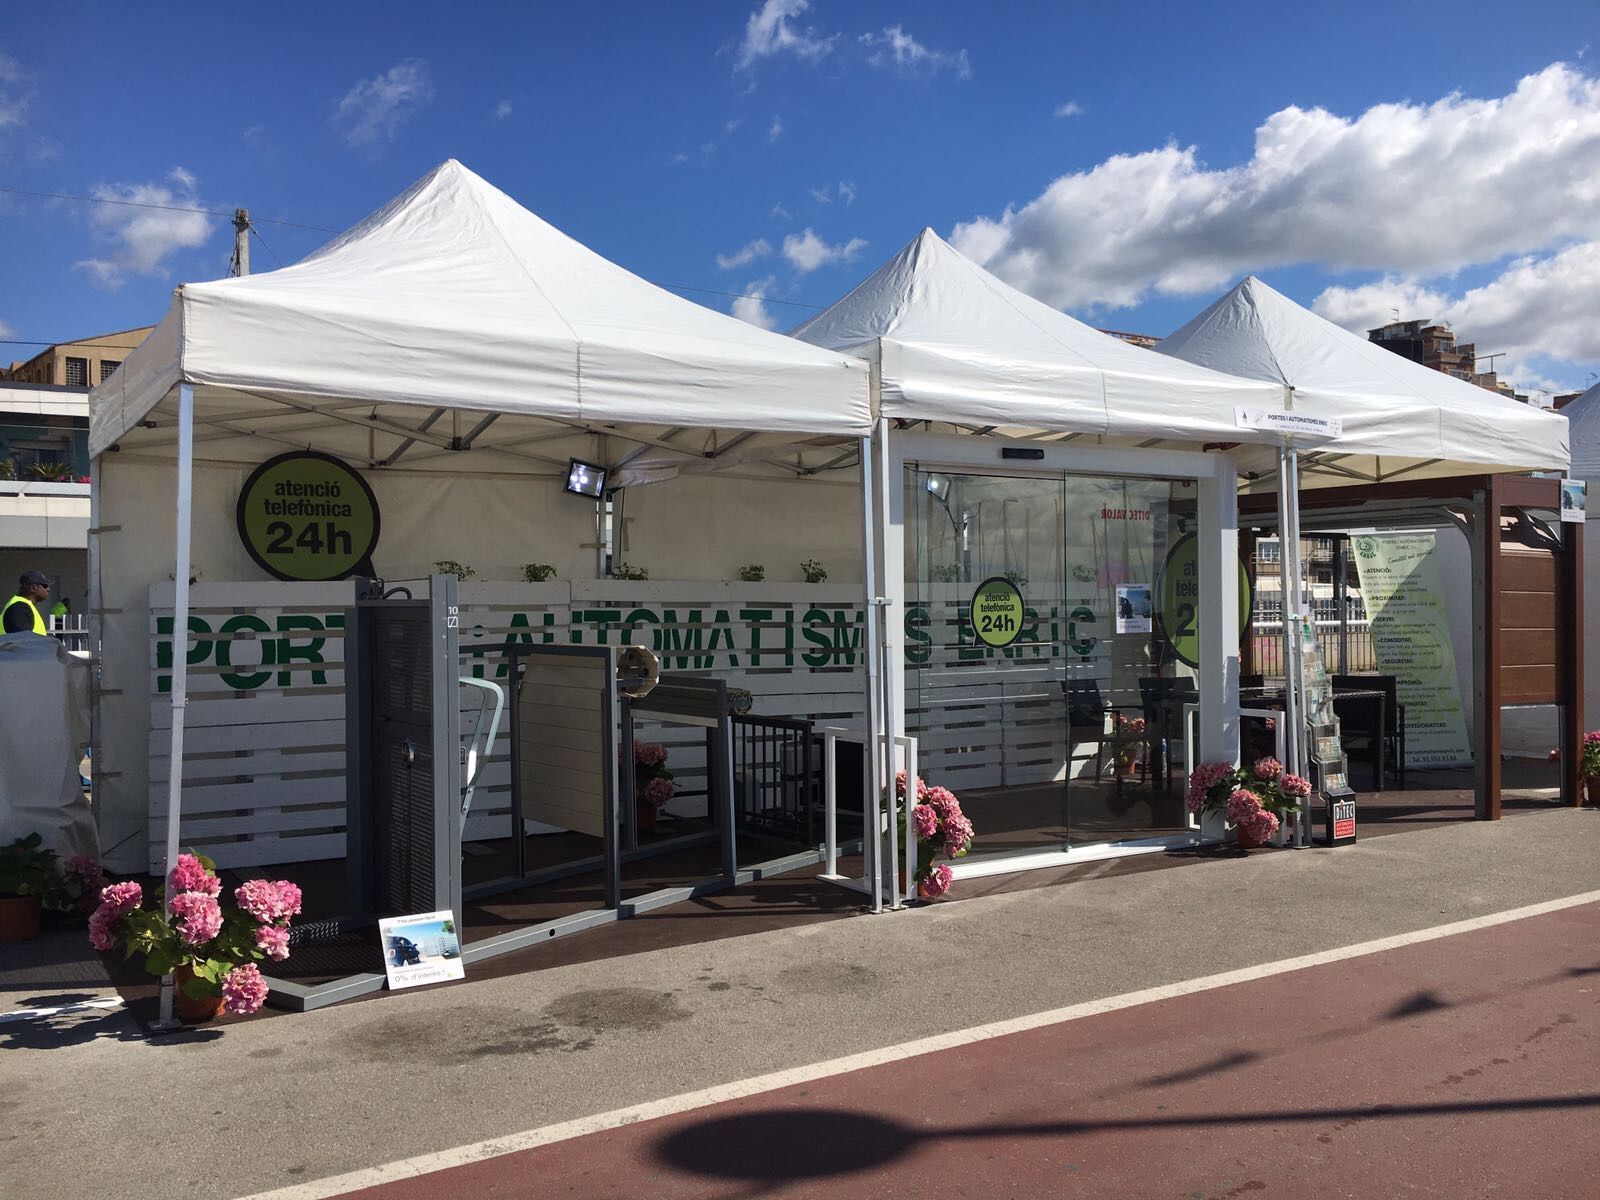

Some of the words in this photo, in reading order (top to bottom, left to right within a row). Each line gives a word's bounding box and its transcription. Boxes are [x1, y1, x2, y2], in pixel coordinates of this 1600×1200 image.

[274, 480, 341, 498] atenció
[264, 499, 352, 517] telefònica
[266, 521, 352, 555] 24h
[984, 592, 1010, 602] atenció
[981, 603, 1014, 612] telefònica
[982, 614, 1014, 632] 24h
